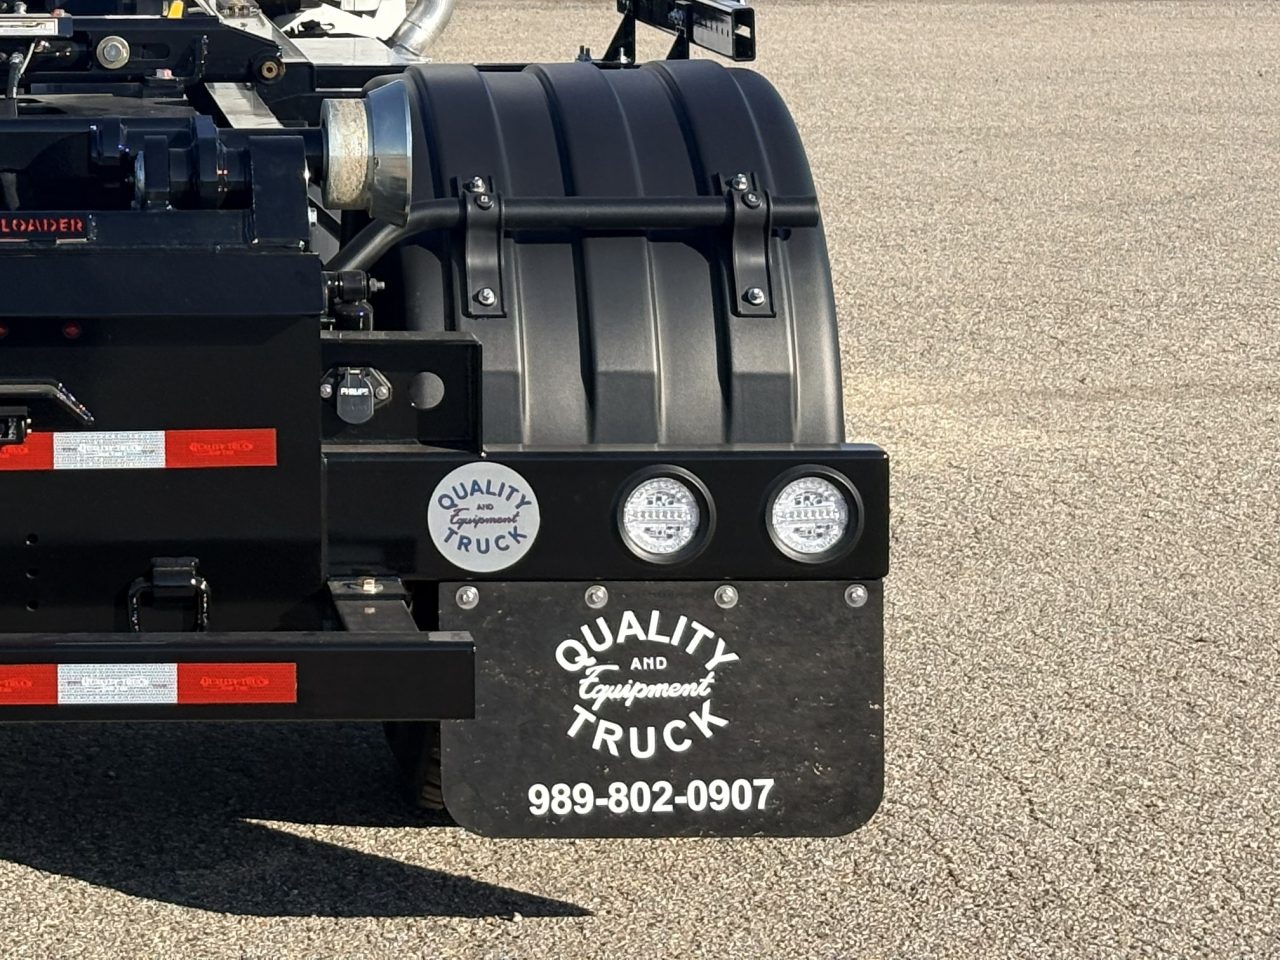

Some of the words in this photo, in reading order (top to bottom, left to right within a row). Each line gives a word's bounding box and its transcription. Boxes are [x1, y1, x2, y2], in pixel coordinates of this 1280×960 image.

[437, 478, 532, 511] QUALITY
[476, 503, 494, 511] AND
[450, 507, 520, 530] Equipment
[444, 525, 528, 555] TRUCK
[555, 609, 740, 672] QUALITY
[630, 656, 668, 671] AND
[578, 664, 715, 712] Equipment
[567, 698, 730, 759] TRUCK
[527, 778, 775, 816] 989-802-0907
